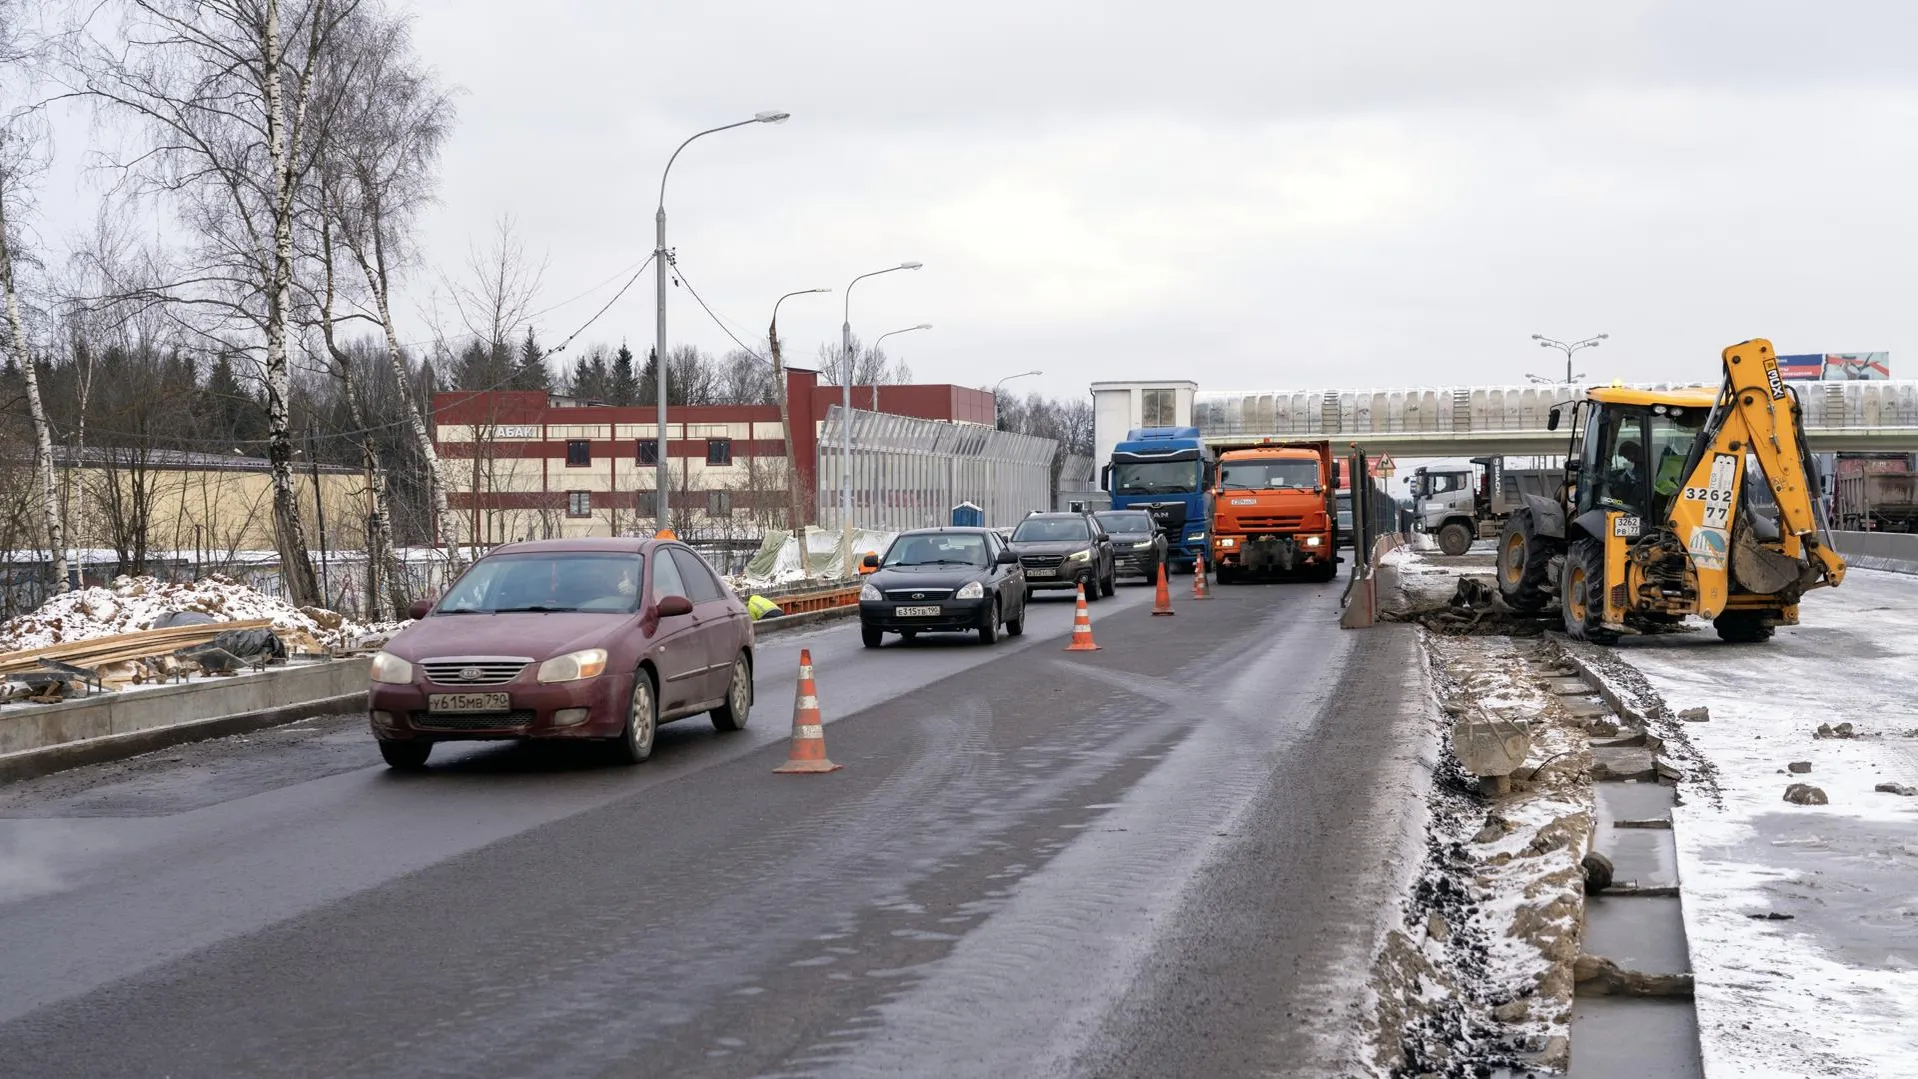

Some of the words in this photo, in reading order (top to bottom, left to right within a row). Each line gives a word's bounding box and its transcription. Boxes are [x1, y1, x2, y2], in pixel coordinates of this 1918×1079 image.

[1686, 488, 1731, 502] 3262
[1706, 506, 1727, 520] 77
[1618, 518, 1637, 526] 3262
[433, 695, 483, 709] У615МВ
